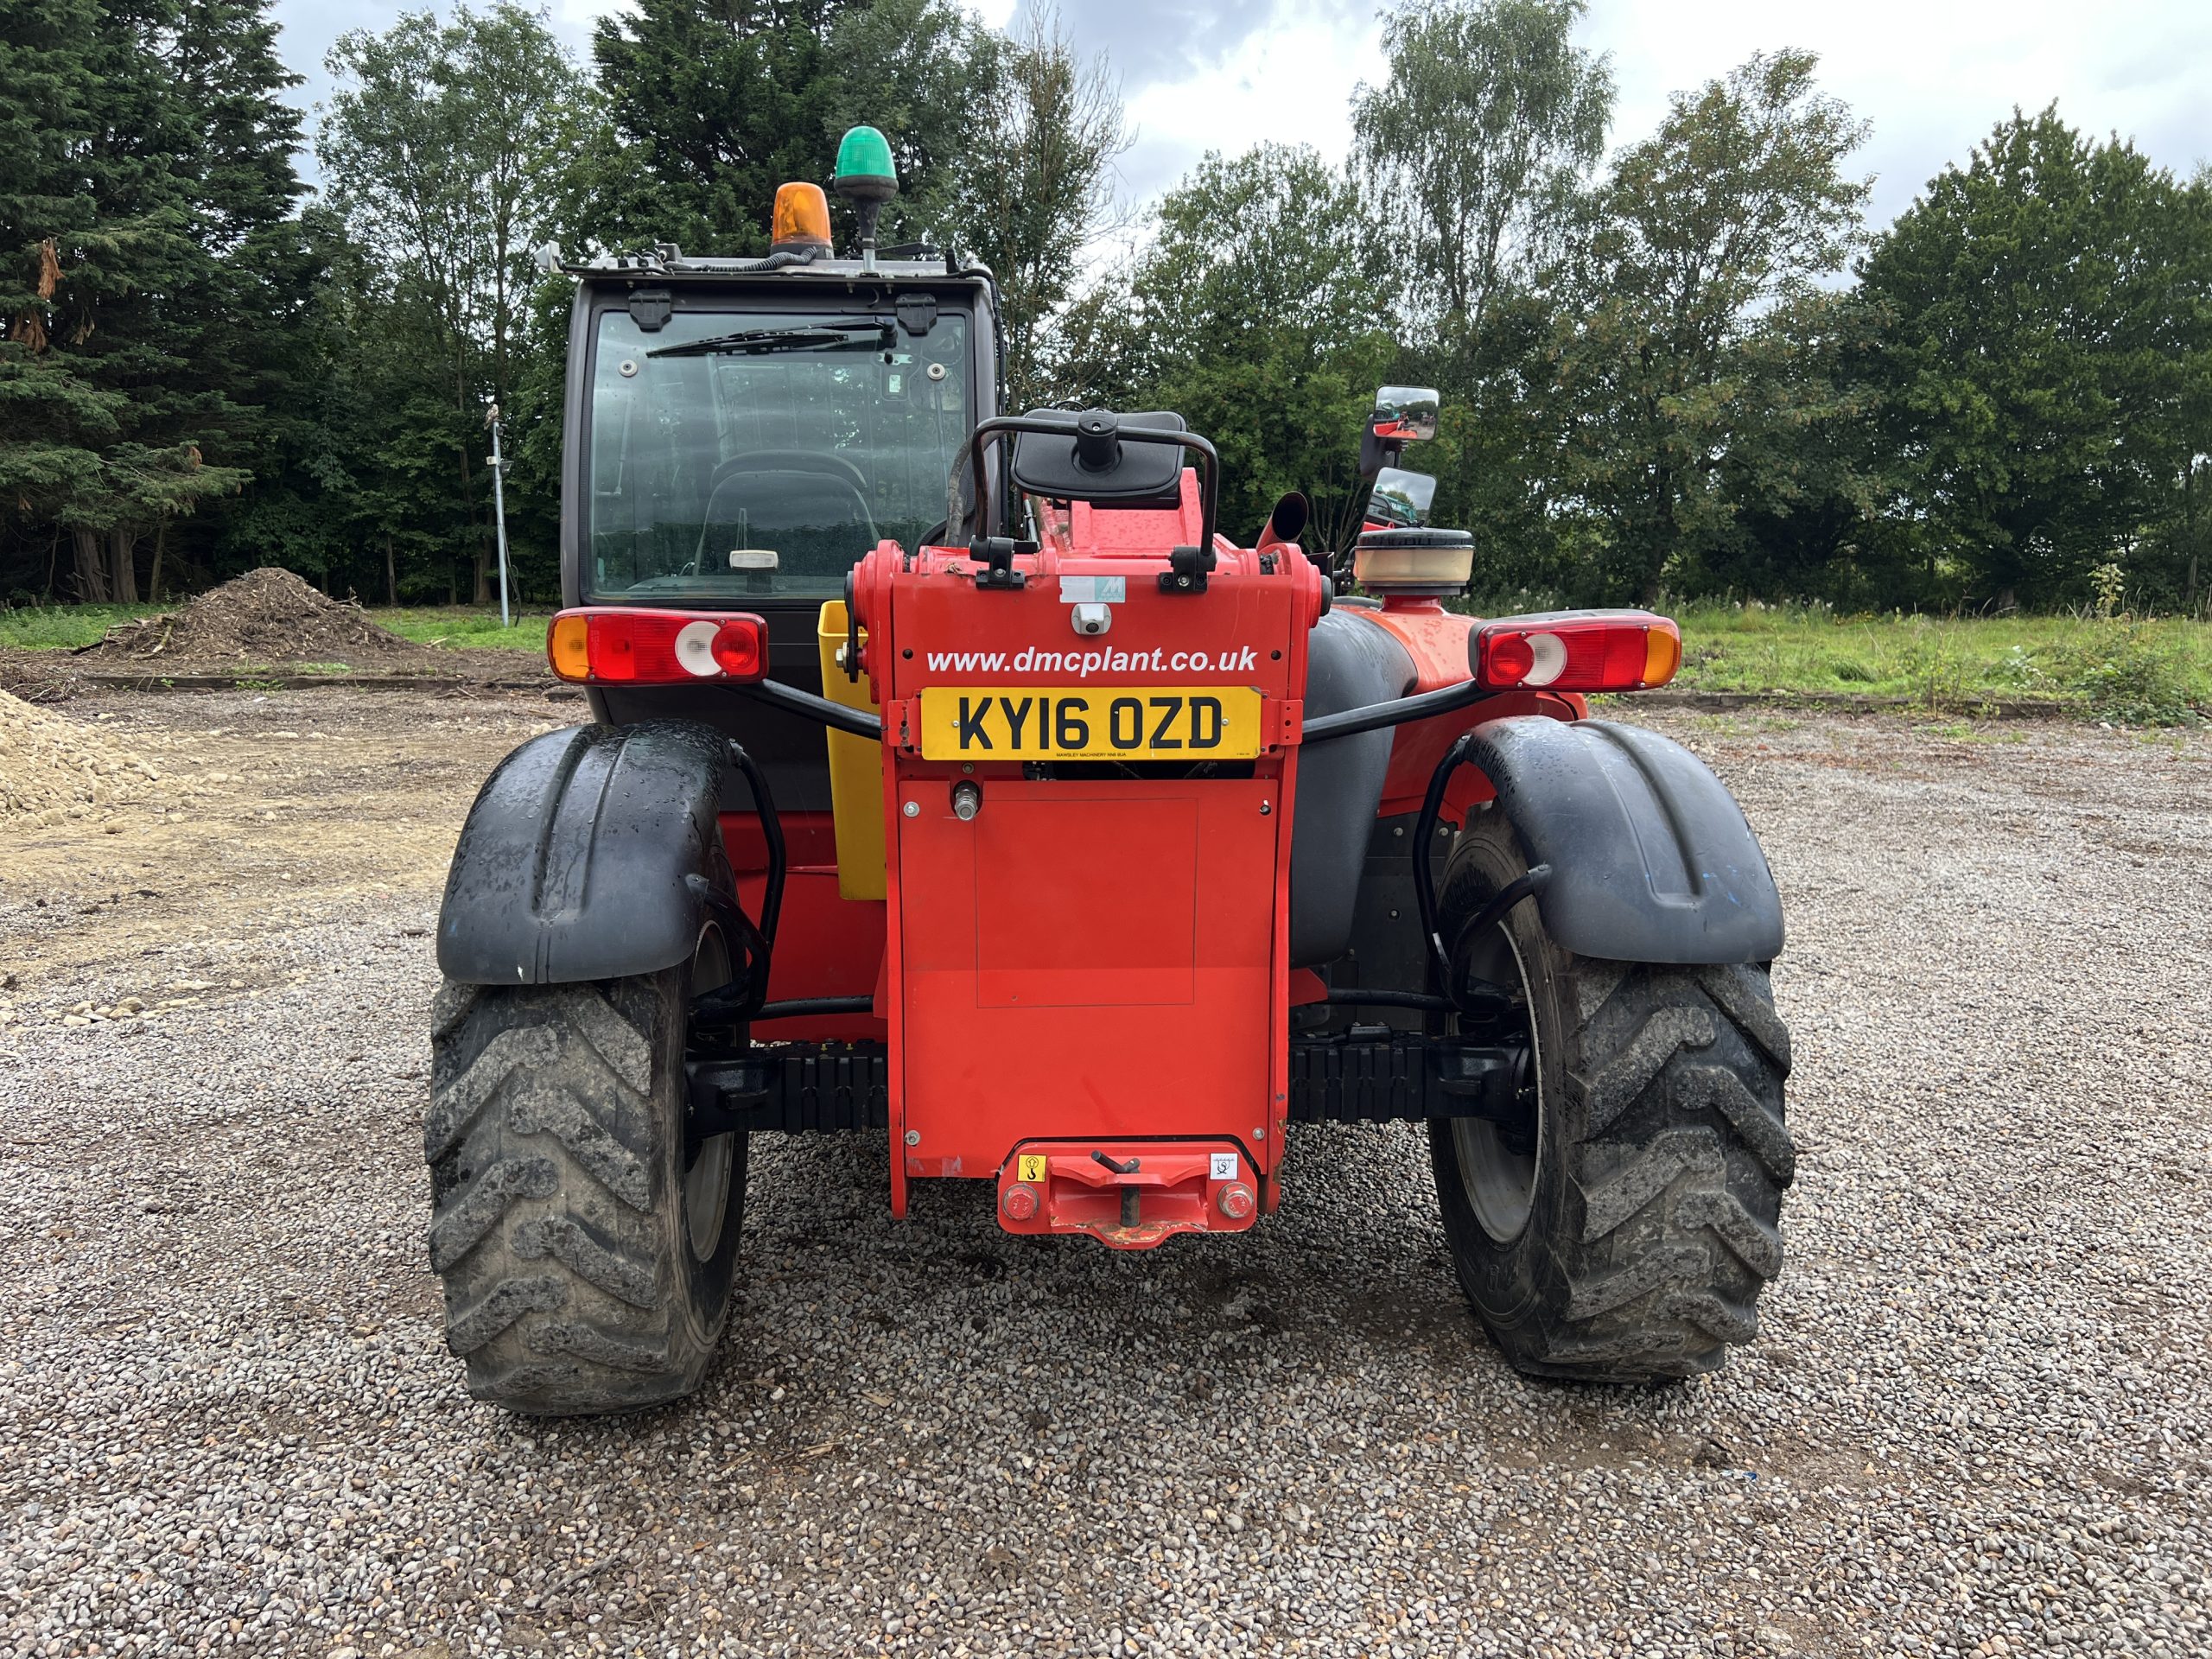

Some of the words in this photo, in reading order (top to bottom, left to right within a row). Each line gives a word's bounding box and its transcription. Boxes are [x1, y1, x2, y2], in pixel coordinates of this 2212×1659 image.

[927, 645, 1258, 678] www.dmcplant.co.uk
[959, 696, 1090, 750] KY16
[1109, 696, 1223, 750] OZD
